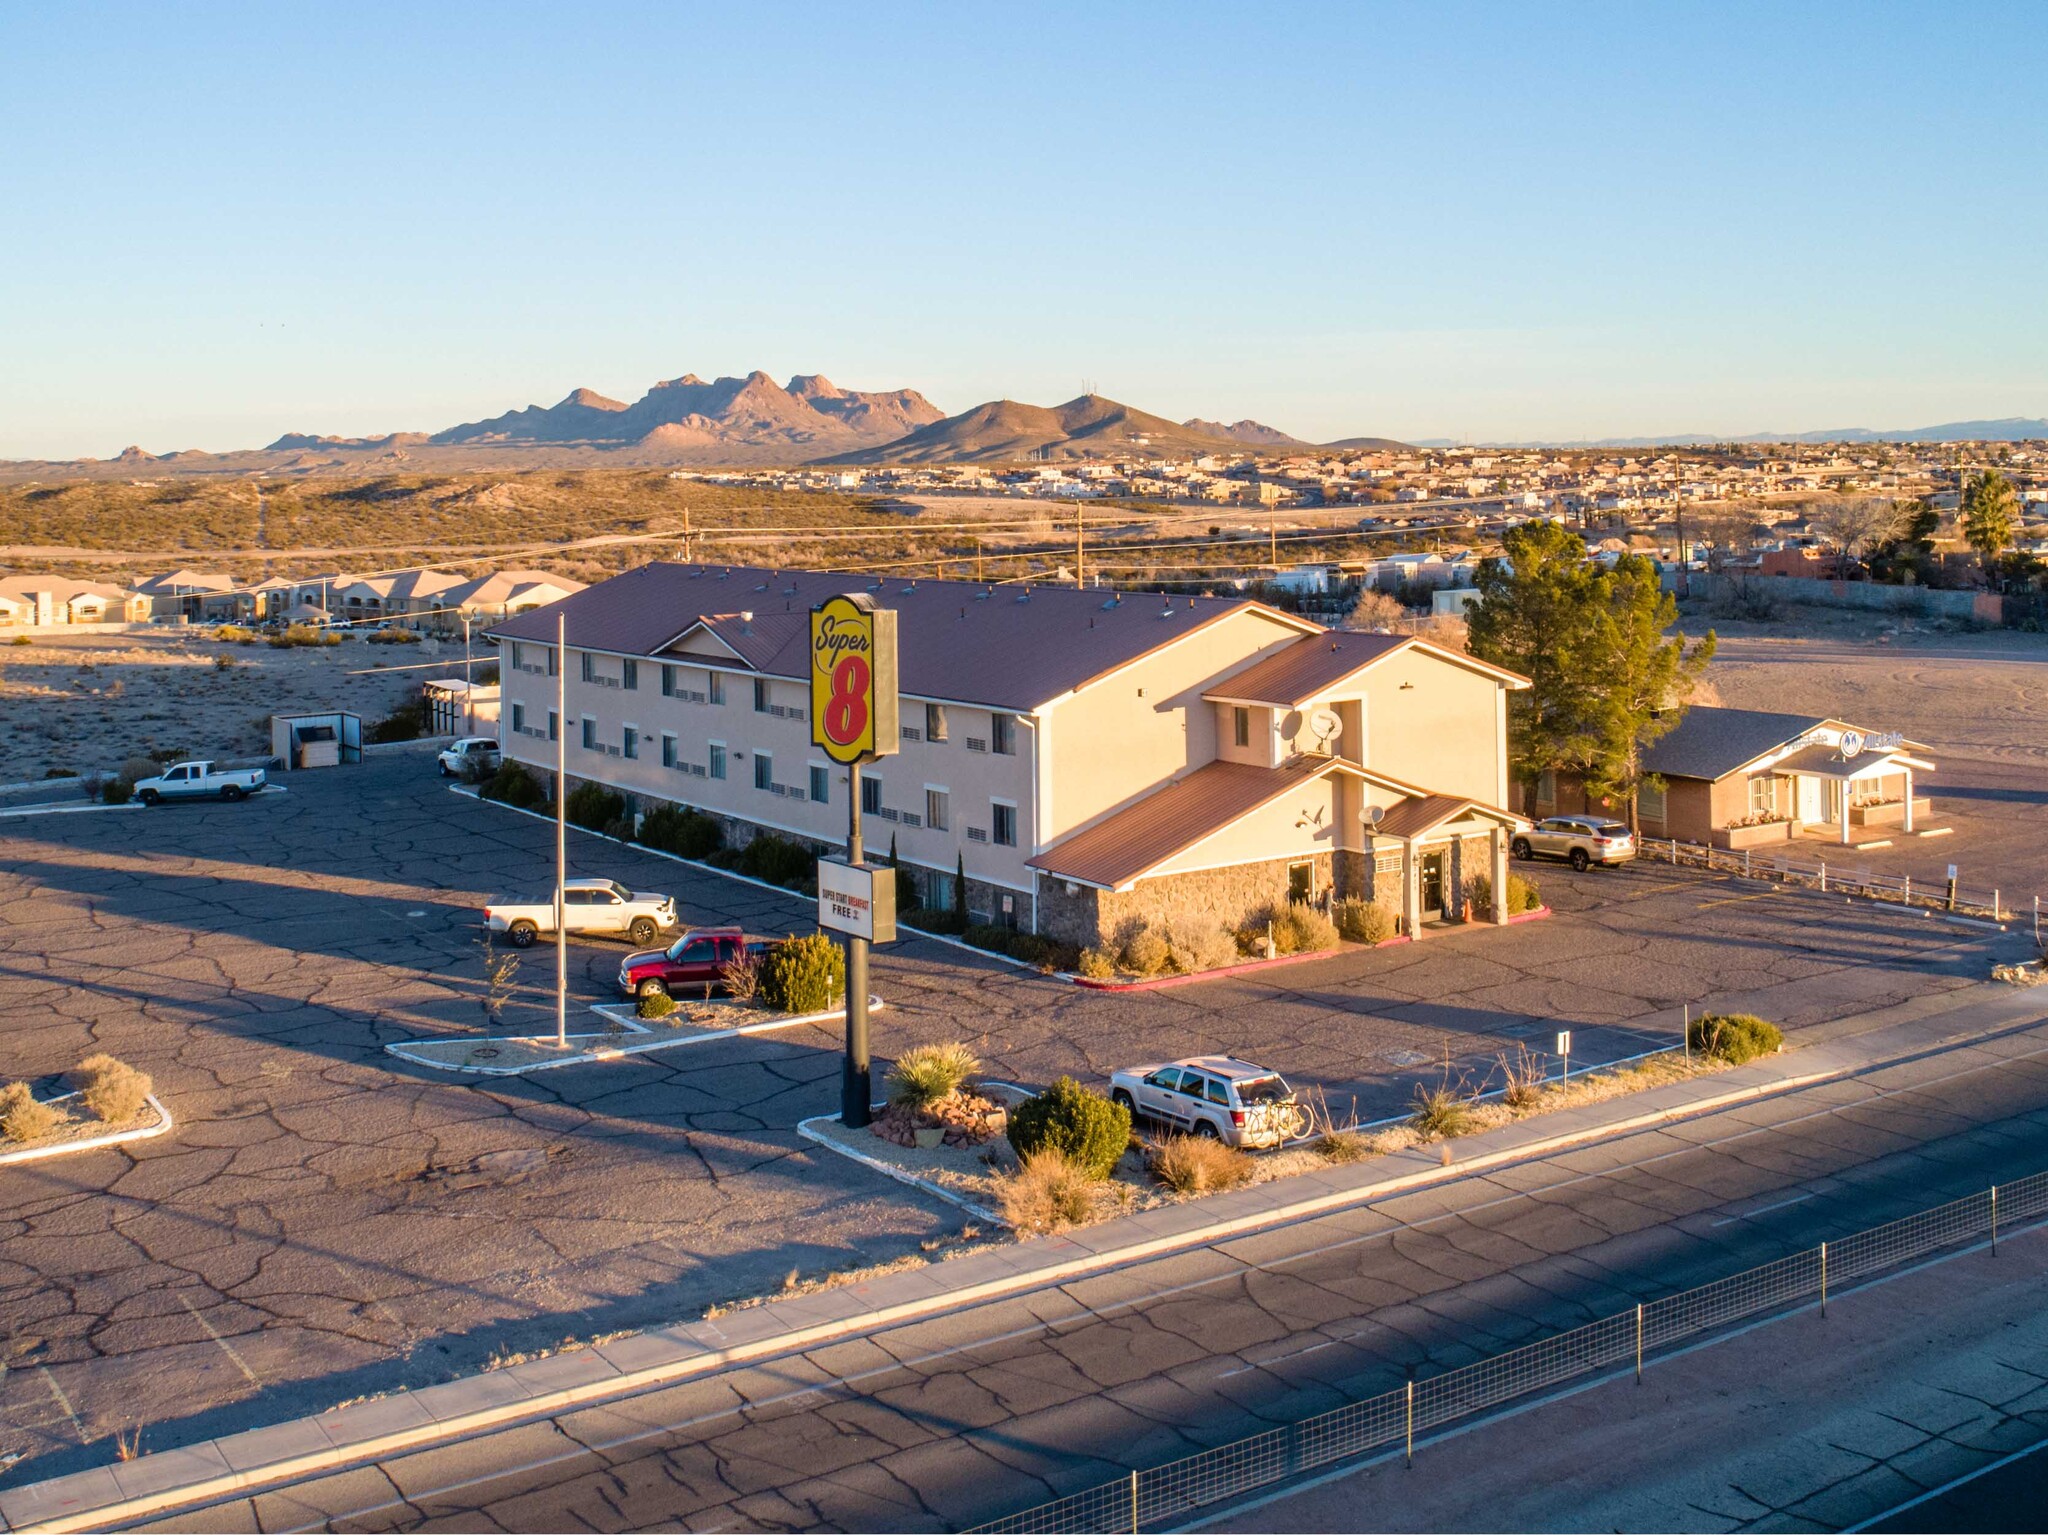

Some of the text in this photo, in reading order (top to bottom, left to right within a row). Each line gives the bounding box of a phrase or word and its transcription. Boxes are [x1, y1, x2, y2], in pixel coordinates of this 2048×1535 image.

[816, 615, 870, 668] Super
[824, 655, 870, 745] 8
[822, 889, 869, 911] SUPER START BREAKFAST
[833, 904, 851, 918] FREE
